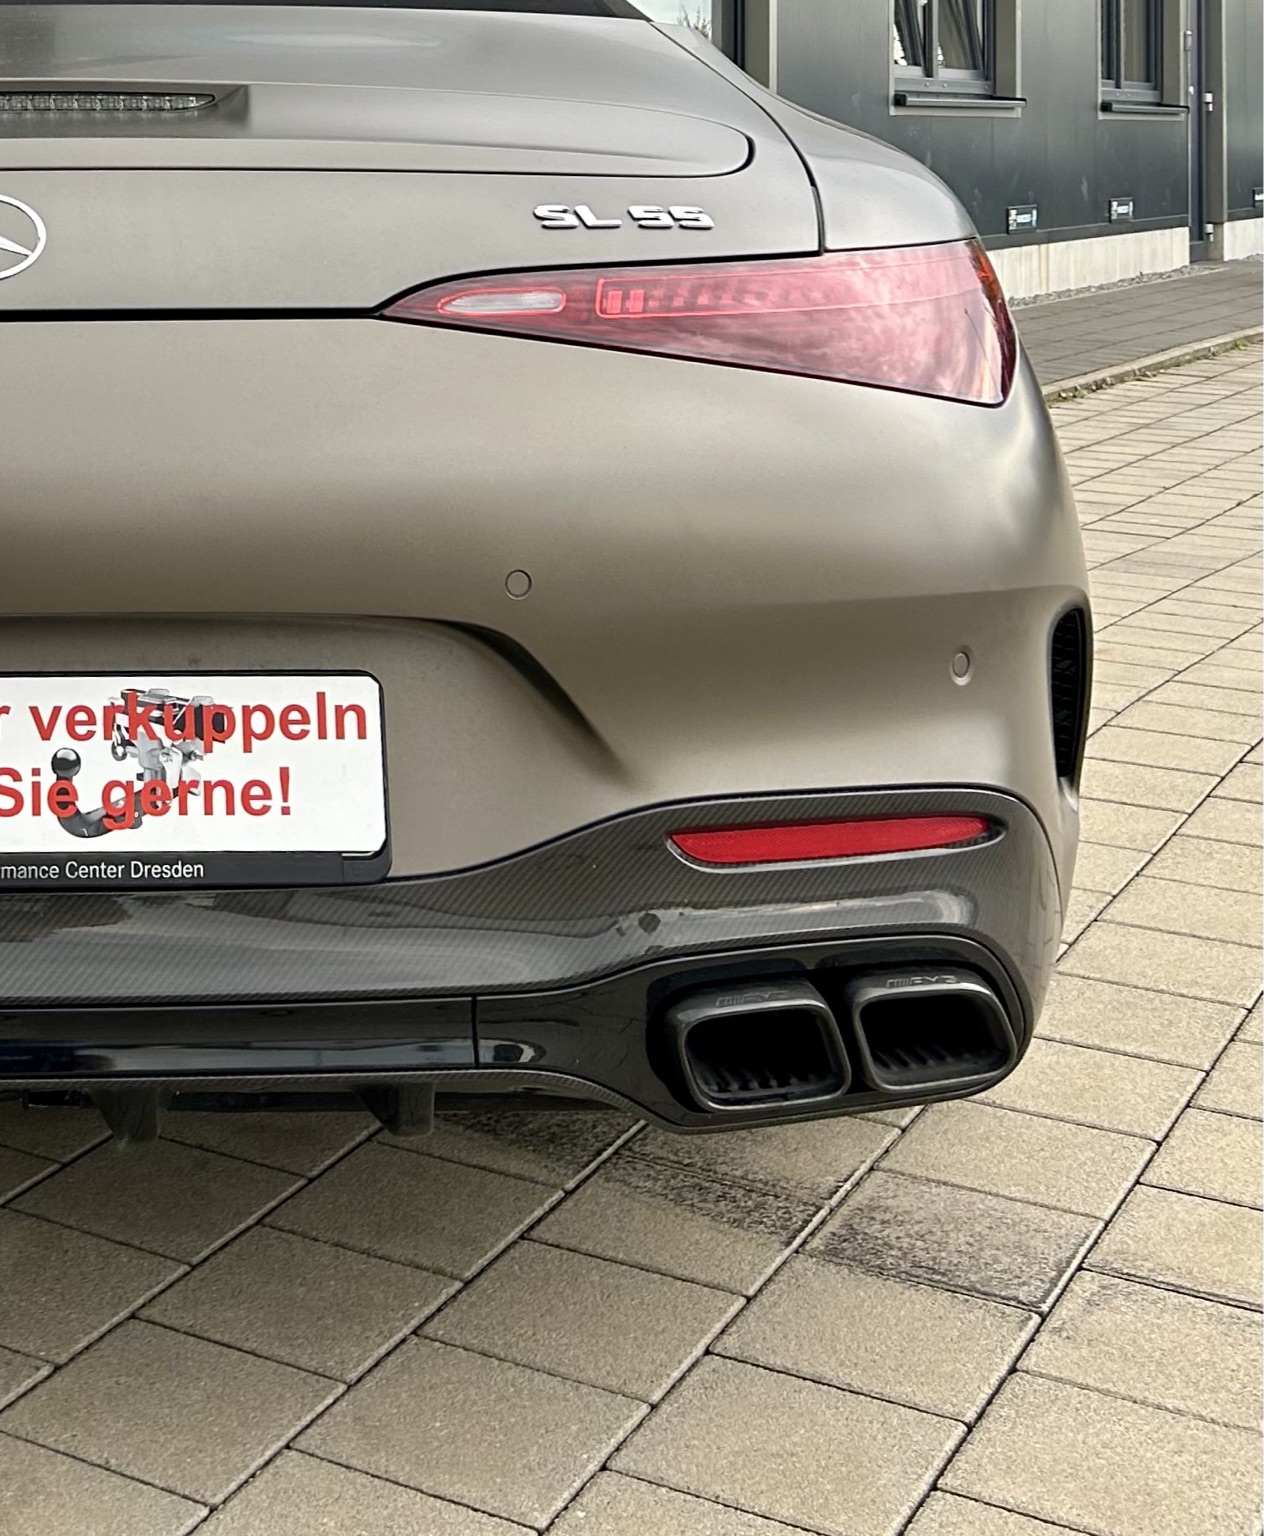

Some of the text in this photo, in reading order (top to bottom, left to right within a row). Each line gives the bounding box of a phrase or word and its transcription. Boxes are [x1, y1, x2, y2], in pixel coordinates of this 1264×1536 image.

[533, 204, 715, 230] SL 55
[28, 691, 367, 754] verkuppeln
[101, 766, 292, 831] gerne!
[65, 861, 125, 880] Center
[130, 860, 205, 879] Dresden
